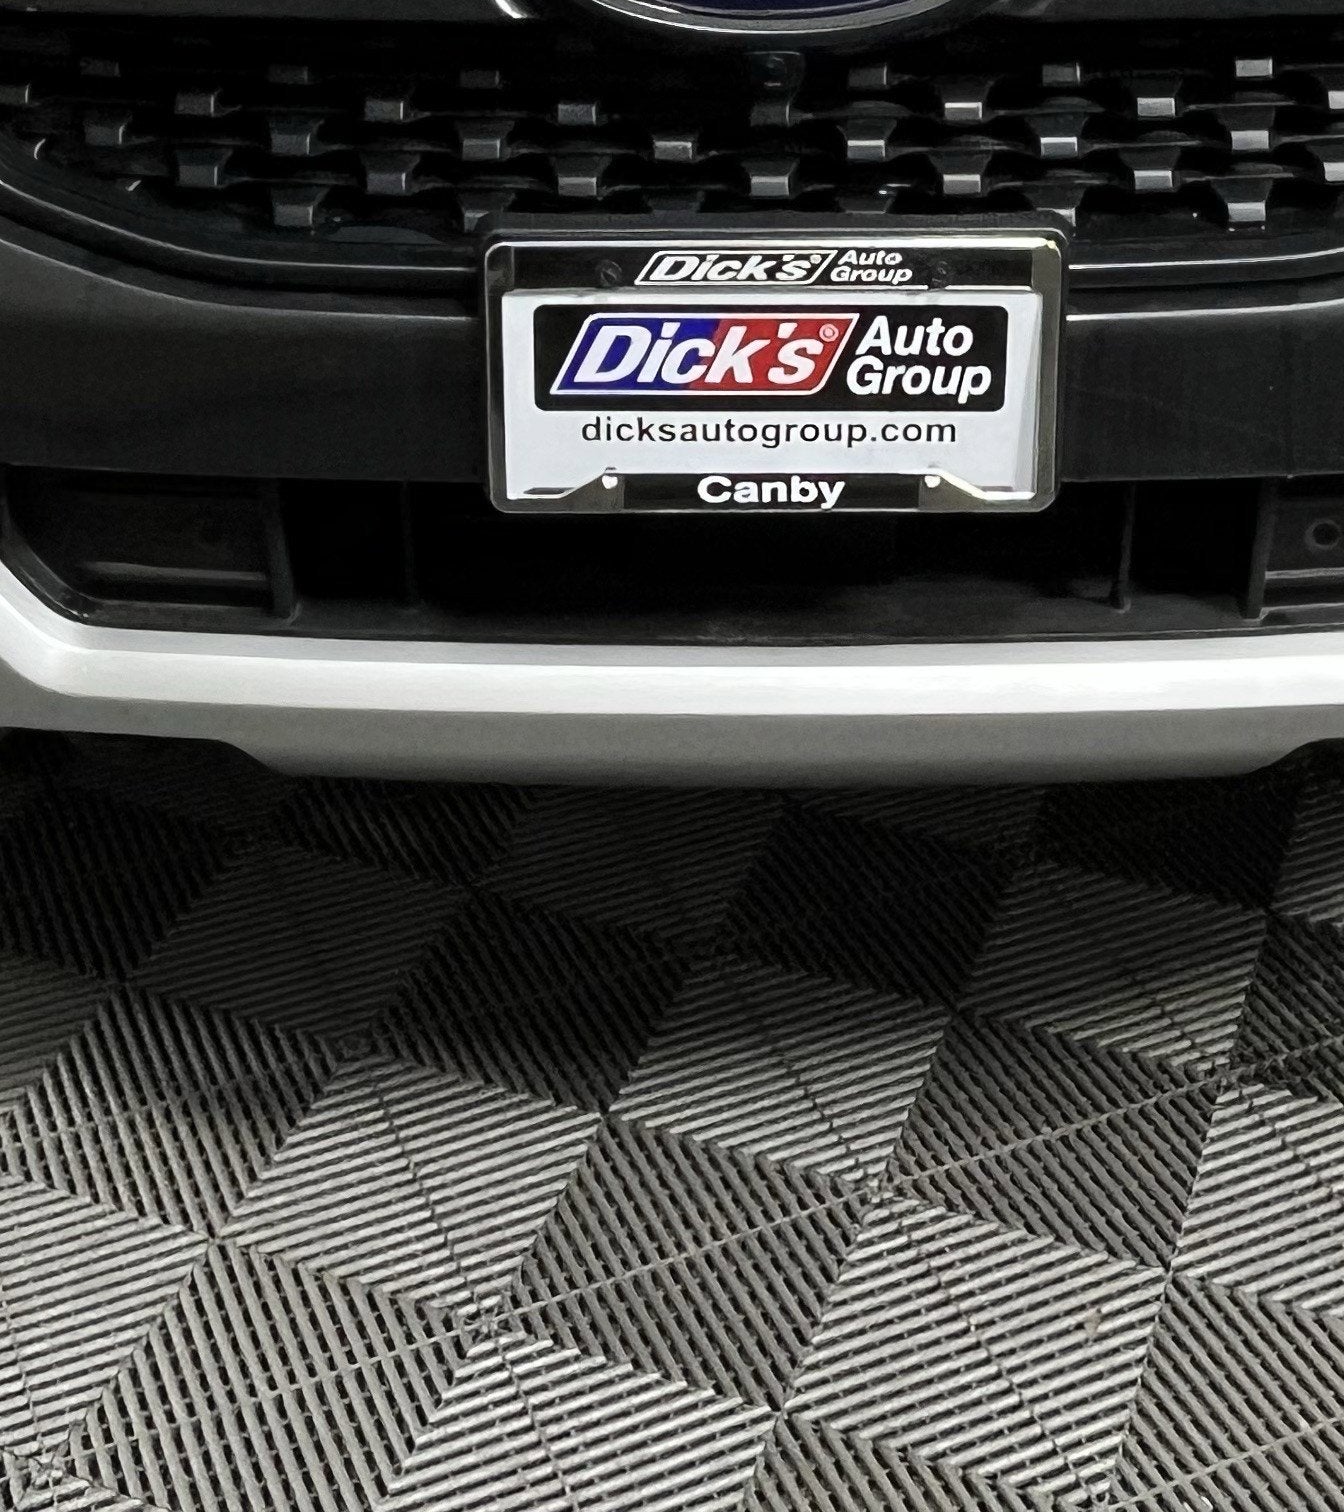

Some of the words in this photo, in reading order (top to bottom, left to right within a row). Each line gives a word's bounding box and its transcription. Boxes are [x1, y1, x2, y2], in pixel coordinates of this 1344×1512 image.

[653, 252, 815, 282] Dick's
[835, 249, 903, 266] Auto
[830, 264, 913, 286] Group
[855, 315, 974, 357] Auto
[573, 321, 823, 385] Dick's
[845, 356, 993, 404] Group
[581, 416, 957, 448] dicksautogroup.com
[697, 475, 846, 509] Canby
